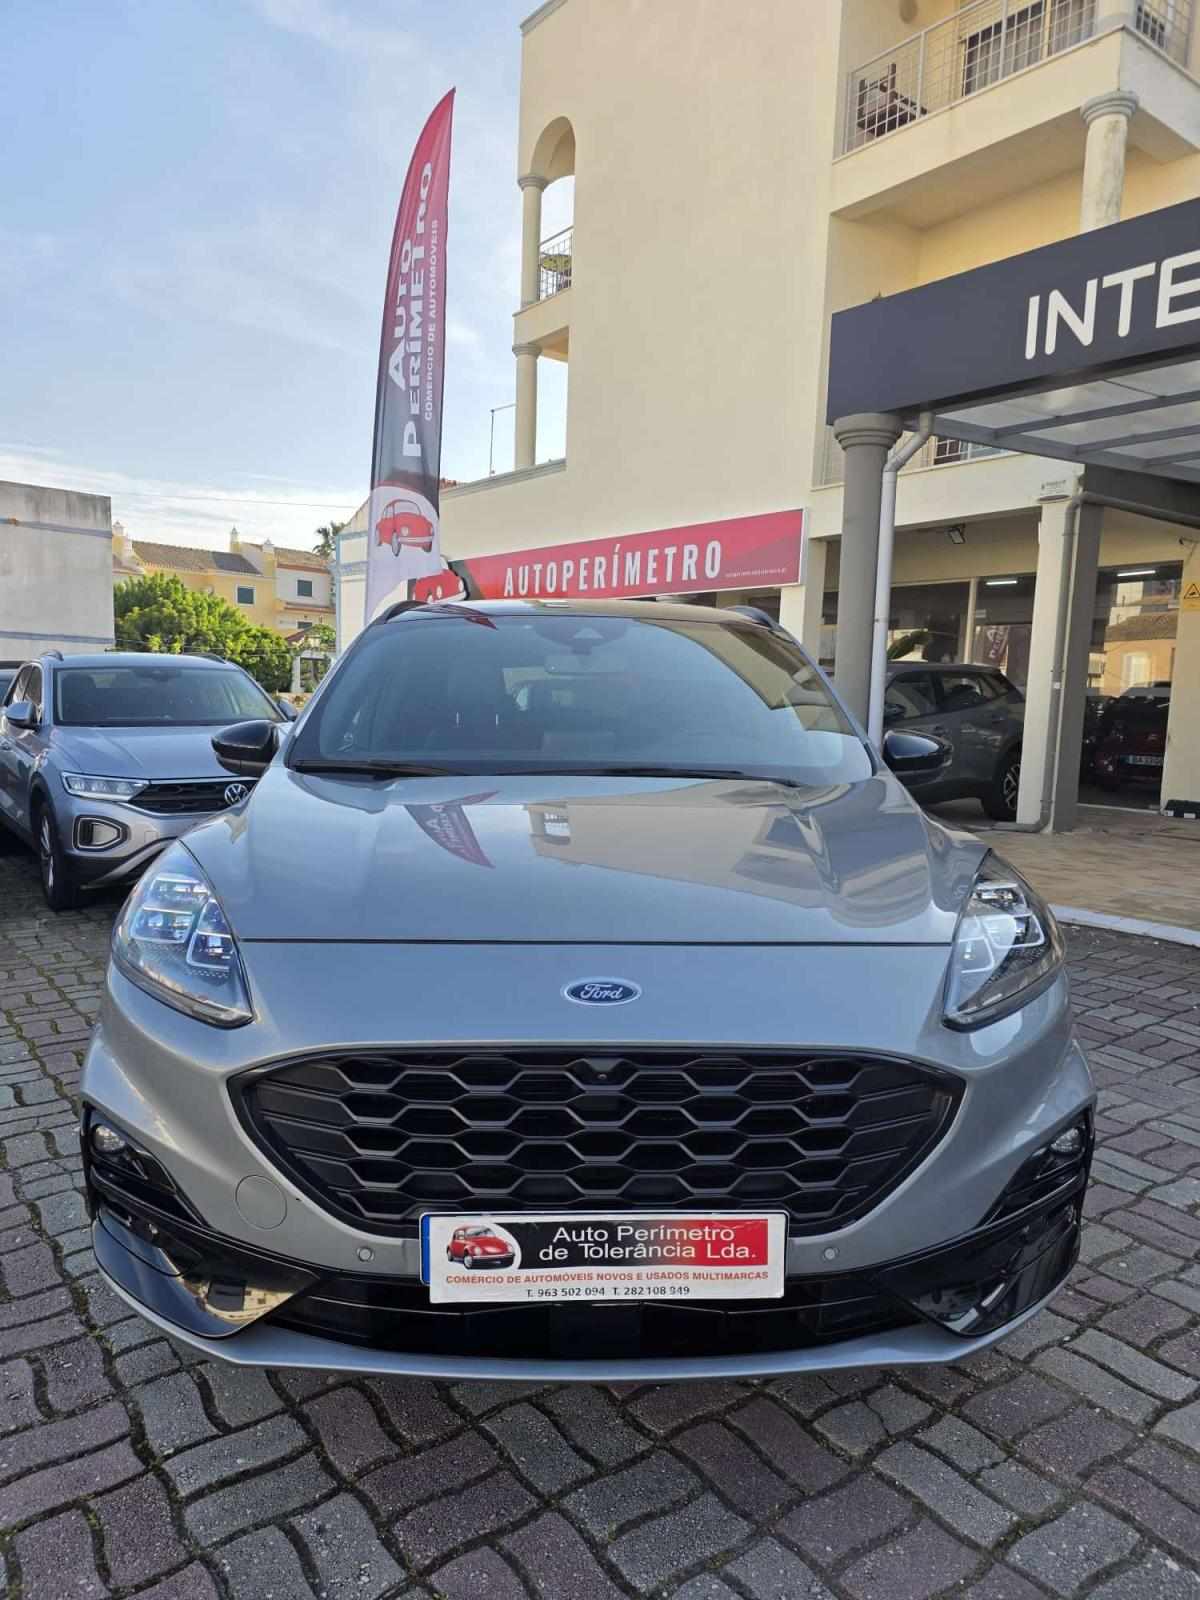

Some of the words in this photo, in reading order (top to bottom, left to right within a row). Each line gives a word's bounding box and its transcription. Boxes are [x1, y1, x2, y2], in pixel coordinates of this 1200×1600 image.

[1025, 249, 1200, 360] INTE
[388, 239, 412, 391] AUTO
[427, 323, 437, 341] DE
[504, 540, 721, 597] AUTOPERÍMETRO
[580, 983, 623, 999] Ford
[552, 1226, 608, 1243] Auto
[617, 1225, 735, 1242] Perímetro
[539, 1245, 569, 1261] de
[577, 1242, 696, 1259] Tolerância
[706, 1242, 757, 1259] Lda.
[507, 1274, 521, 1284] DE
[596, 1271, 633, 1281] NOVOS
[636, 1272, 643, 1281] E
[646, 1271, 690, 1281] USADOS
[692, 1271, 769, 1281] MULTIMARCAS
[537, 1288, 558, 1298] 963
[560, 1287, 581, 1297] 502
[584, 1286, 605, 1296] 094
[623, 1286, 644, 1296] 282
[646, 1286, 667, 1296] 108
